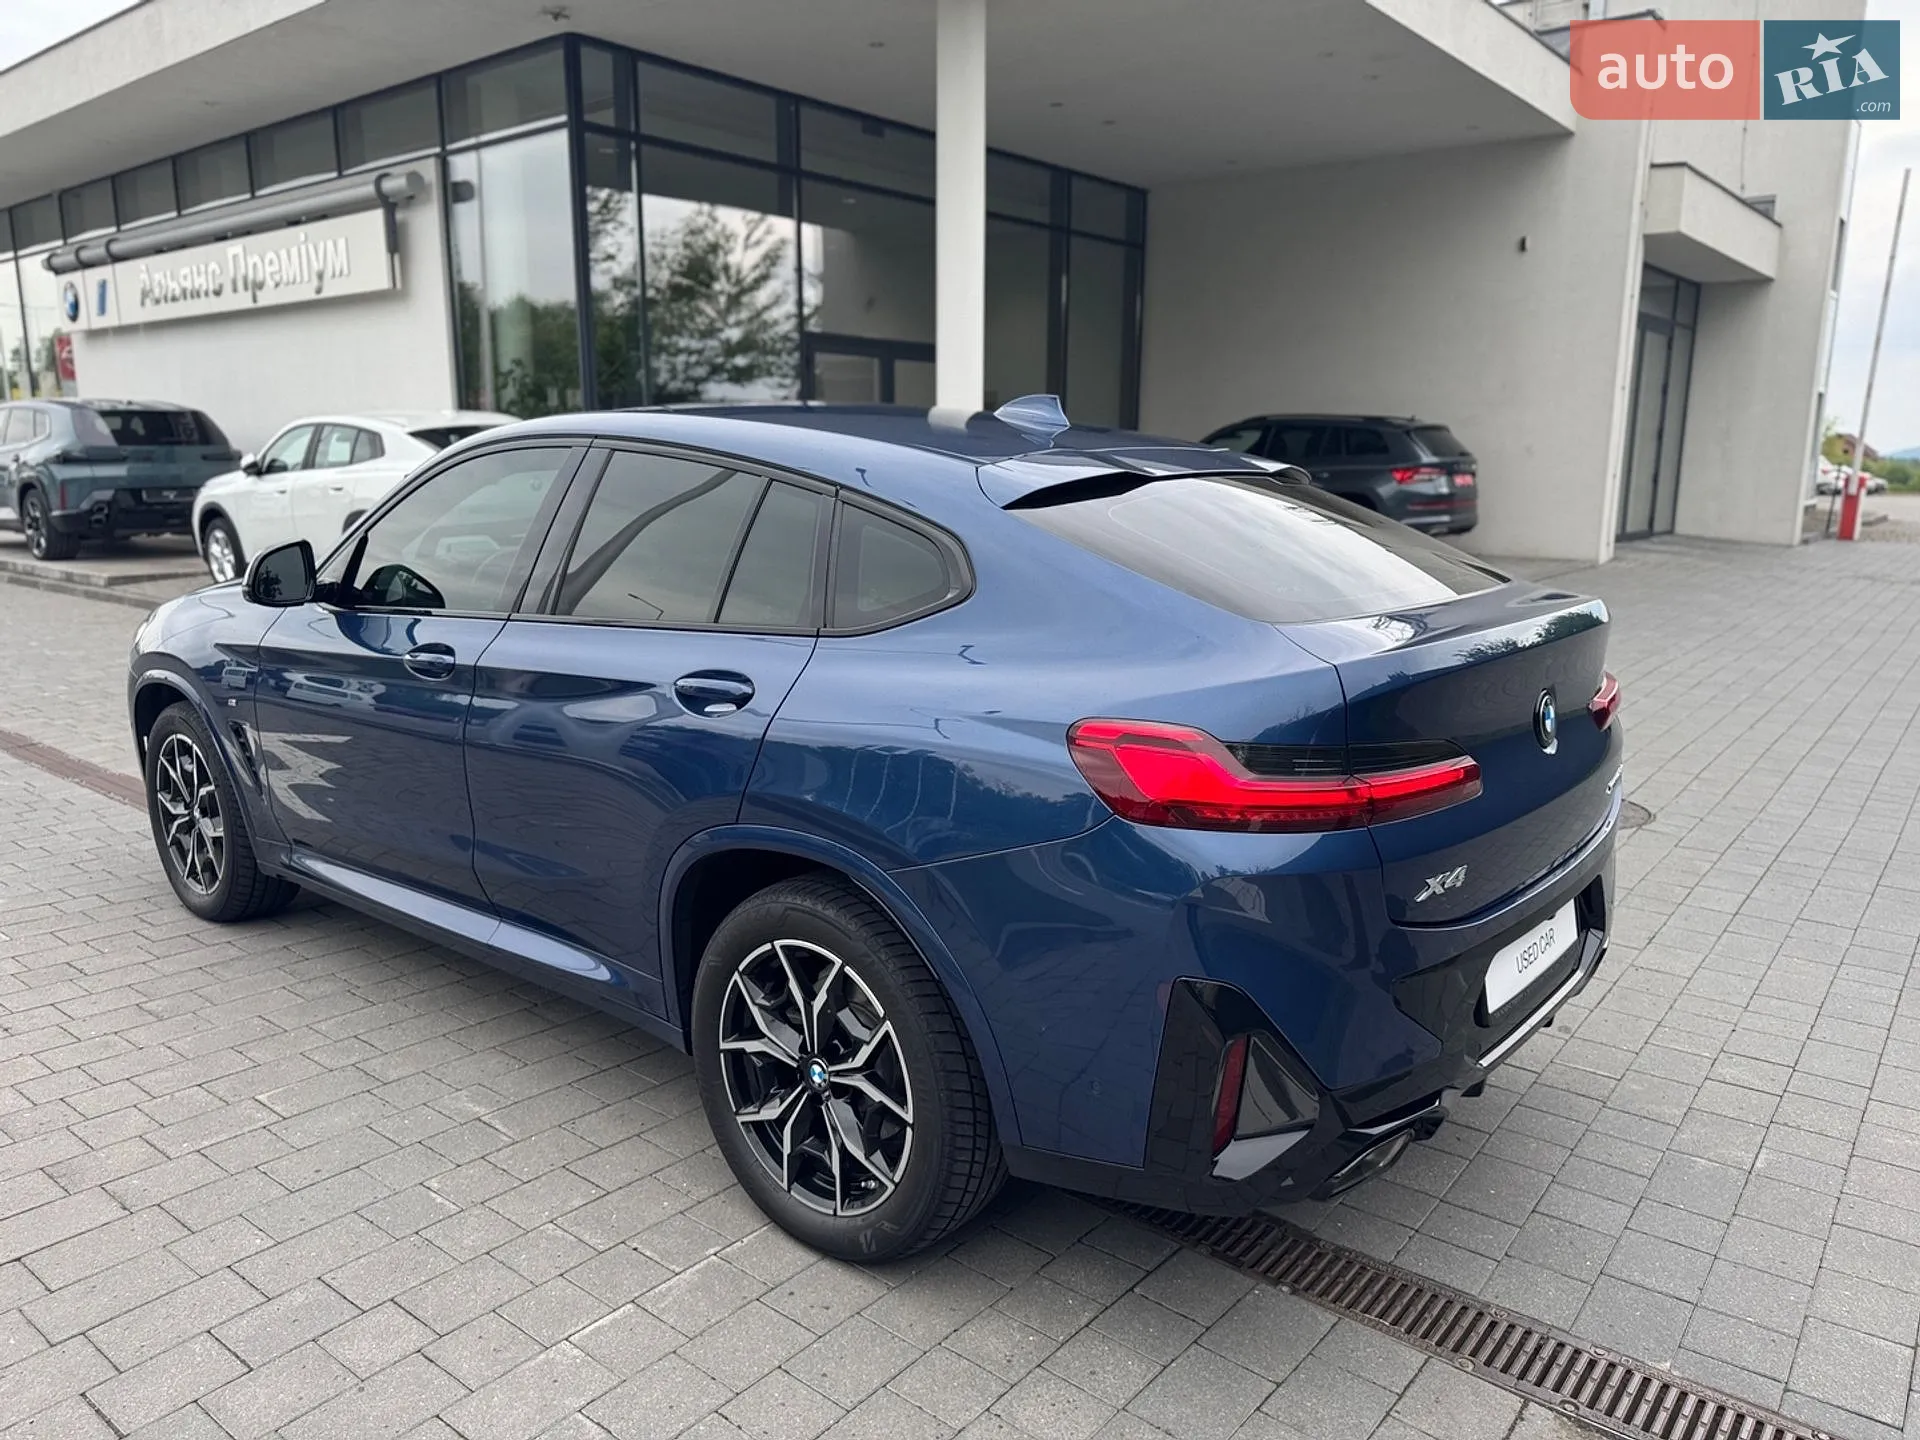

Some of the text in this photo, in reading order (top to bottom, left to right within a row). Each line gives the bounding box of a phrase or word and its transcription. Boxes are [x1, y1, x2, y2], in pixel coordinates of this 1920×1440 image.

[139, 232, 350, 307] Альянс Преміум
[1414, 863, 1469, 903] X4
[1515, 927, 1556, 974] USED CAR
